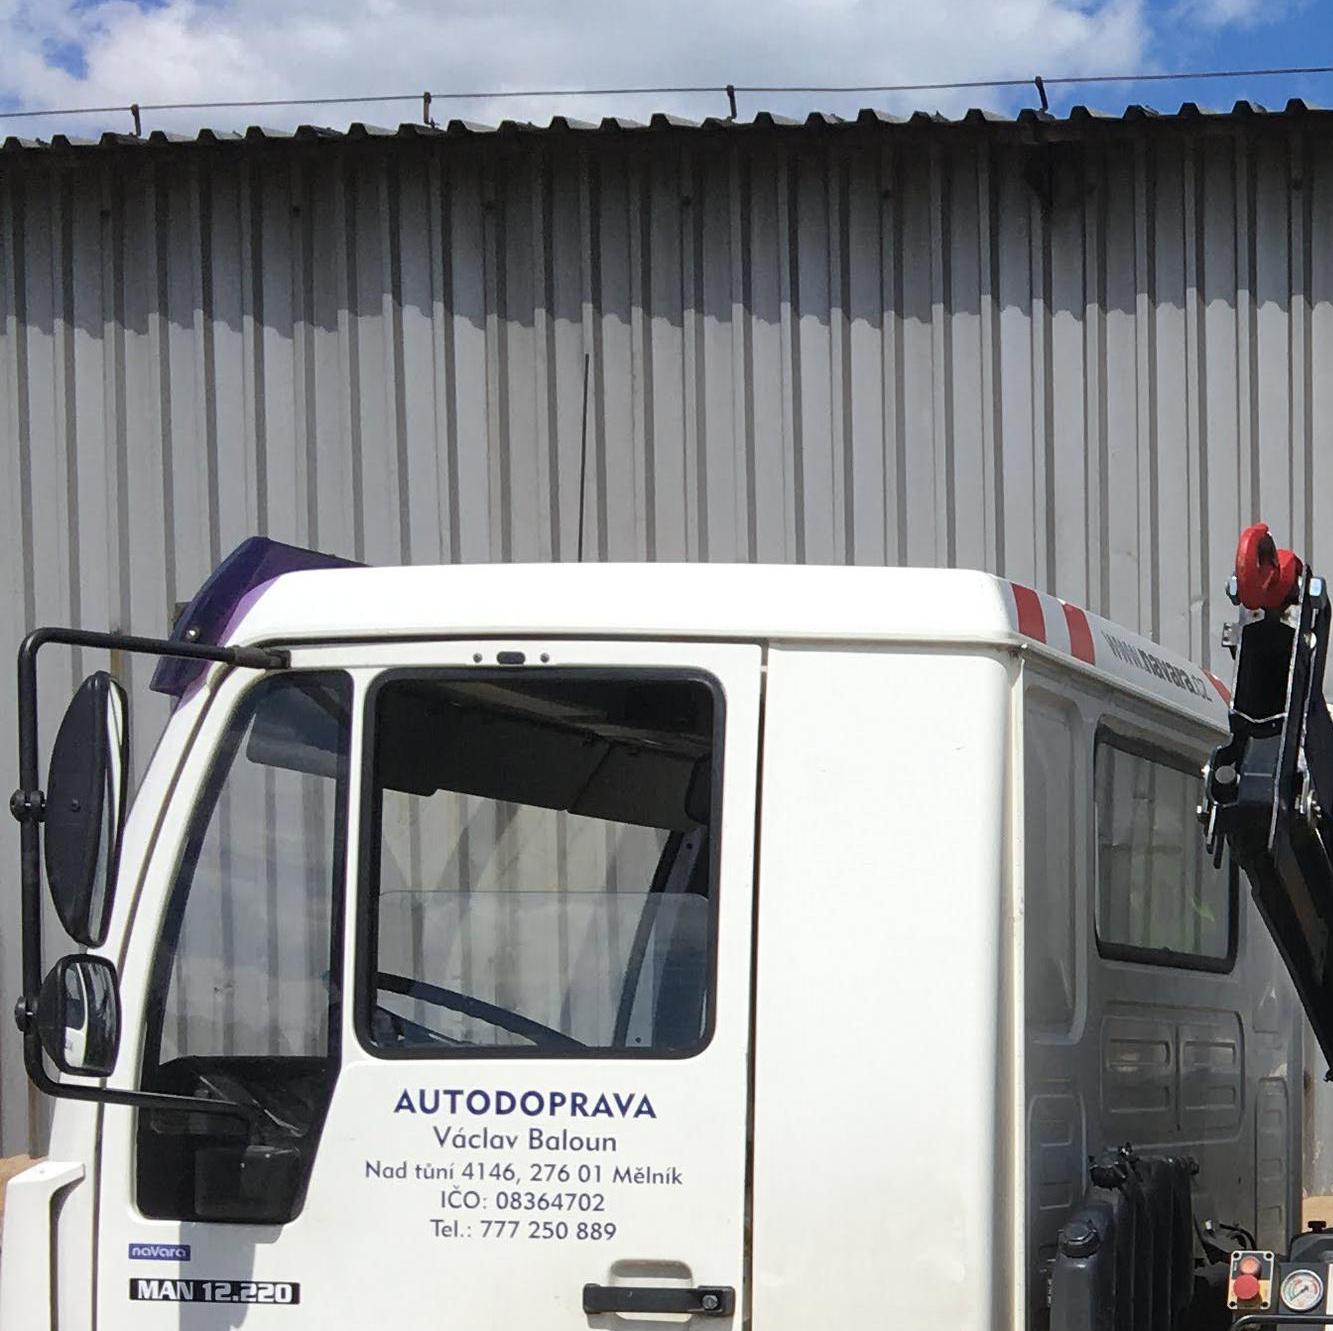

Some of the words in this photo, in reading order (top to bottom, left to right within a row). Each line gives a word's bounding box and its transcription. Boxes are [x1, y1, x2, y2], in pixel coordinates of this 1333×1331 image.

[1101, 630, 1213, 702] www.navara.cz
[393, 1088, 657, 1119] AUTODOPRAVA
[432, 1125, 519, 1150] Václav
[528, 1127, 617, 1152] Baloun
[365, 1160, 408, 1179] Nad
[415, 1161, 455, 1181] tůní
[461, 1162, 522, 1186] 4146,
[529, 1163, 571, 1183] 276
[577, 1164, 602, 1183] 01
[612, 1165, 684, 1186] Mělník
[441, 1184, 488, 1210] IČO:
[495, 1191, 606, 1212] 08364702
[429, 1218, 473, 1239] Tel.:
[480, 1219, 520, 1239] 777
[528, 1220, 570, 1240] 250
[576, 1221, 618, 1241] 889
[137, 1279, 194, 1300] MAN
[201, 1281, 294, 1303] 12.220
